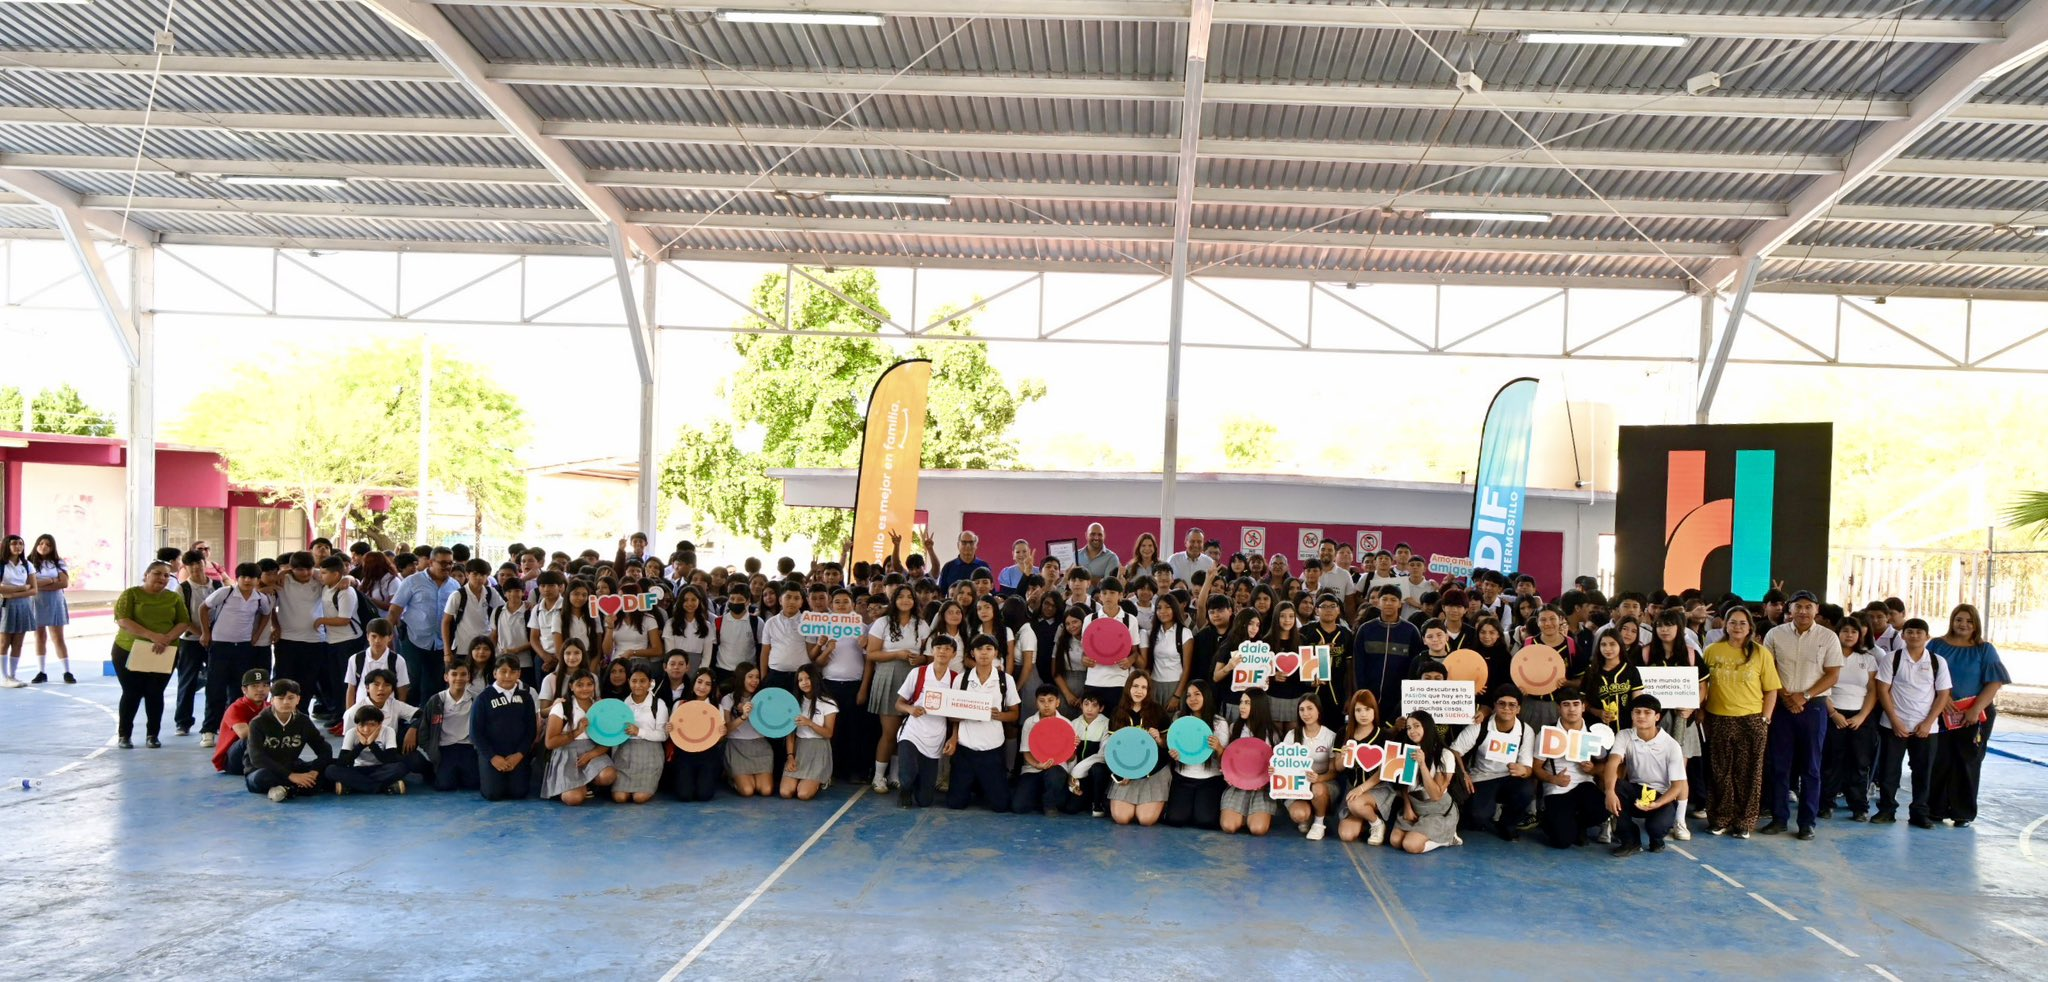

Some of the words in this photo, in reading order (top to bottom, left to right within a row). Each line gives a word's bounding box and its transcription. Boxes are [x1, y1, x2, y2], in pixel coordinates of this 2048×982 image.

[883, 400, 901, 450] familia.
[884, 454, 893, 470] en
[879, 473, 892, 512] mejor
[879, 515, 887, 530] es
[1474, 486, 1507, 572] DIF
[1503, 491, 1518, 573] HERMOSILLO
[873, 533, 885, 567] osillo
[1432, 555, 1450, 563] Amo
[1459, 558, 1472, 567] mis
[1430, 563, 1473, 576] amigos
[590, 596, 597, 616] i
[623, 593, 657, 611] DIF
[803, 613, 829, 622] Amo
[831, 615, 838, 623] a
[841, 613, 860, 624] mis
[801, 622, 861, 638] amigos
[1241, 643, 1268, 653] dale
[1241, 655, 1269, 663] ollow
[255, 672, 262, 680] B
[1235, 670, 1264, 683] DIF
[491, 696, 508, 708] OLD
[951, 702, 990, 711] HERMOSILLO
[1276, 745, 1308, 757] dale
[1489, 739, 1517, 755] DIF
[1542, 728, 1602, 761] DIF
[1273, 757, 1311, 768] follow
[1273, 774, 1306, 790] DIF
